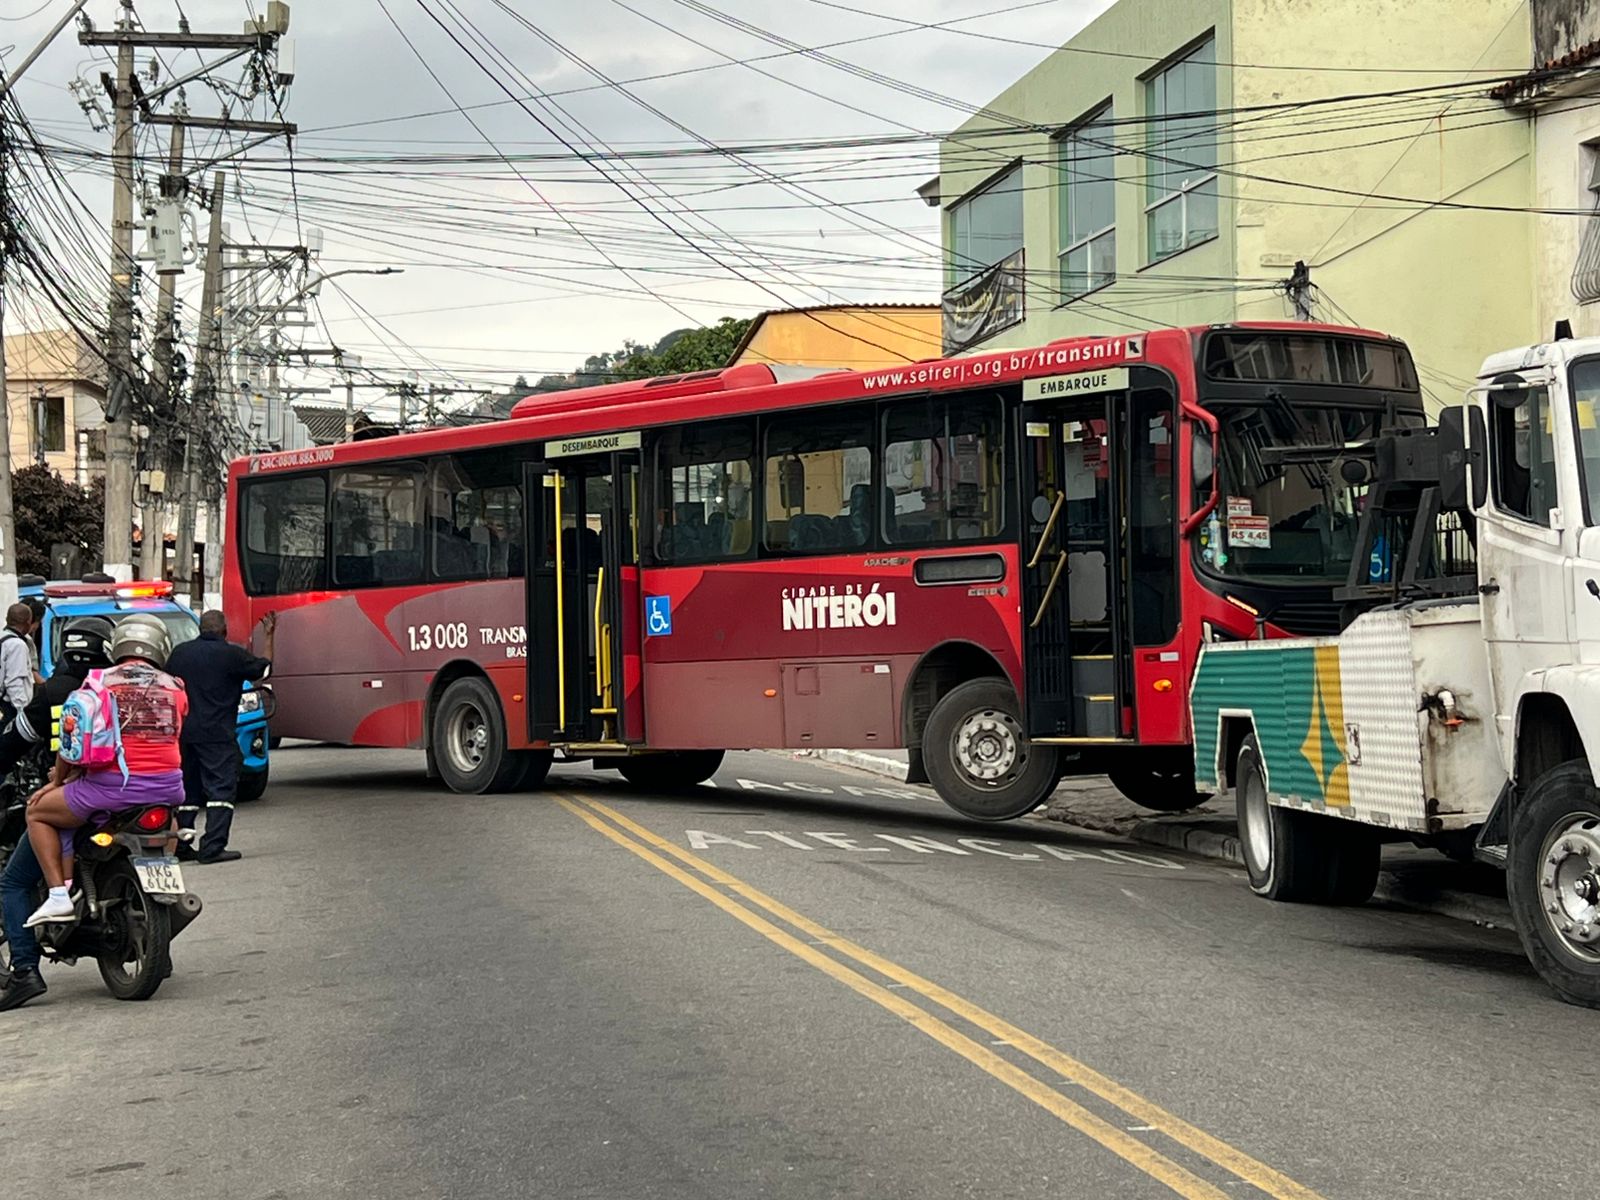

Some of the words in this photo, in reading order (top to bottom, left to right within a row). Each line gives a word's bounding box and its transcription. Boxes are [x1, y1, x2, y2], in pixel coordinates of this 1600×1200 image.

[1040, 374, 1107, 394] EMBARQUE
[561, 437, 620, 453] DESEMBARQUE
[782, 586, 835, 598] CIDADE
[846, 584, 863, 595] DE
[782, 583, 896, 630] NITERÓI
